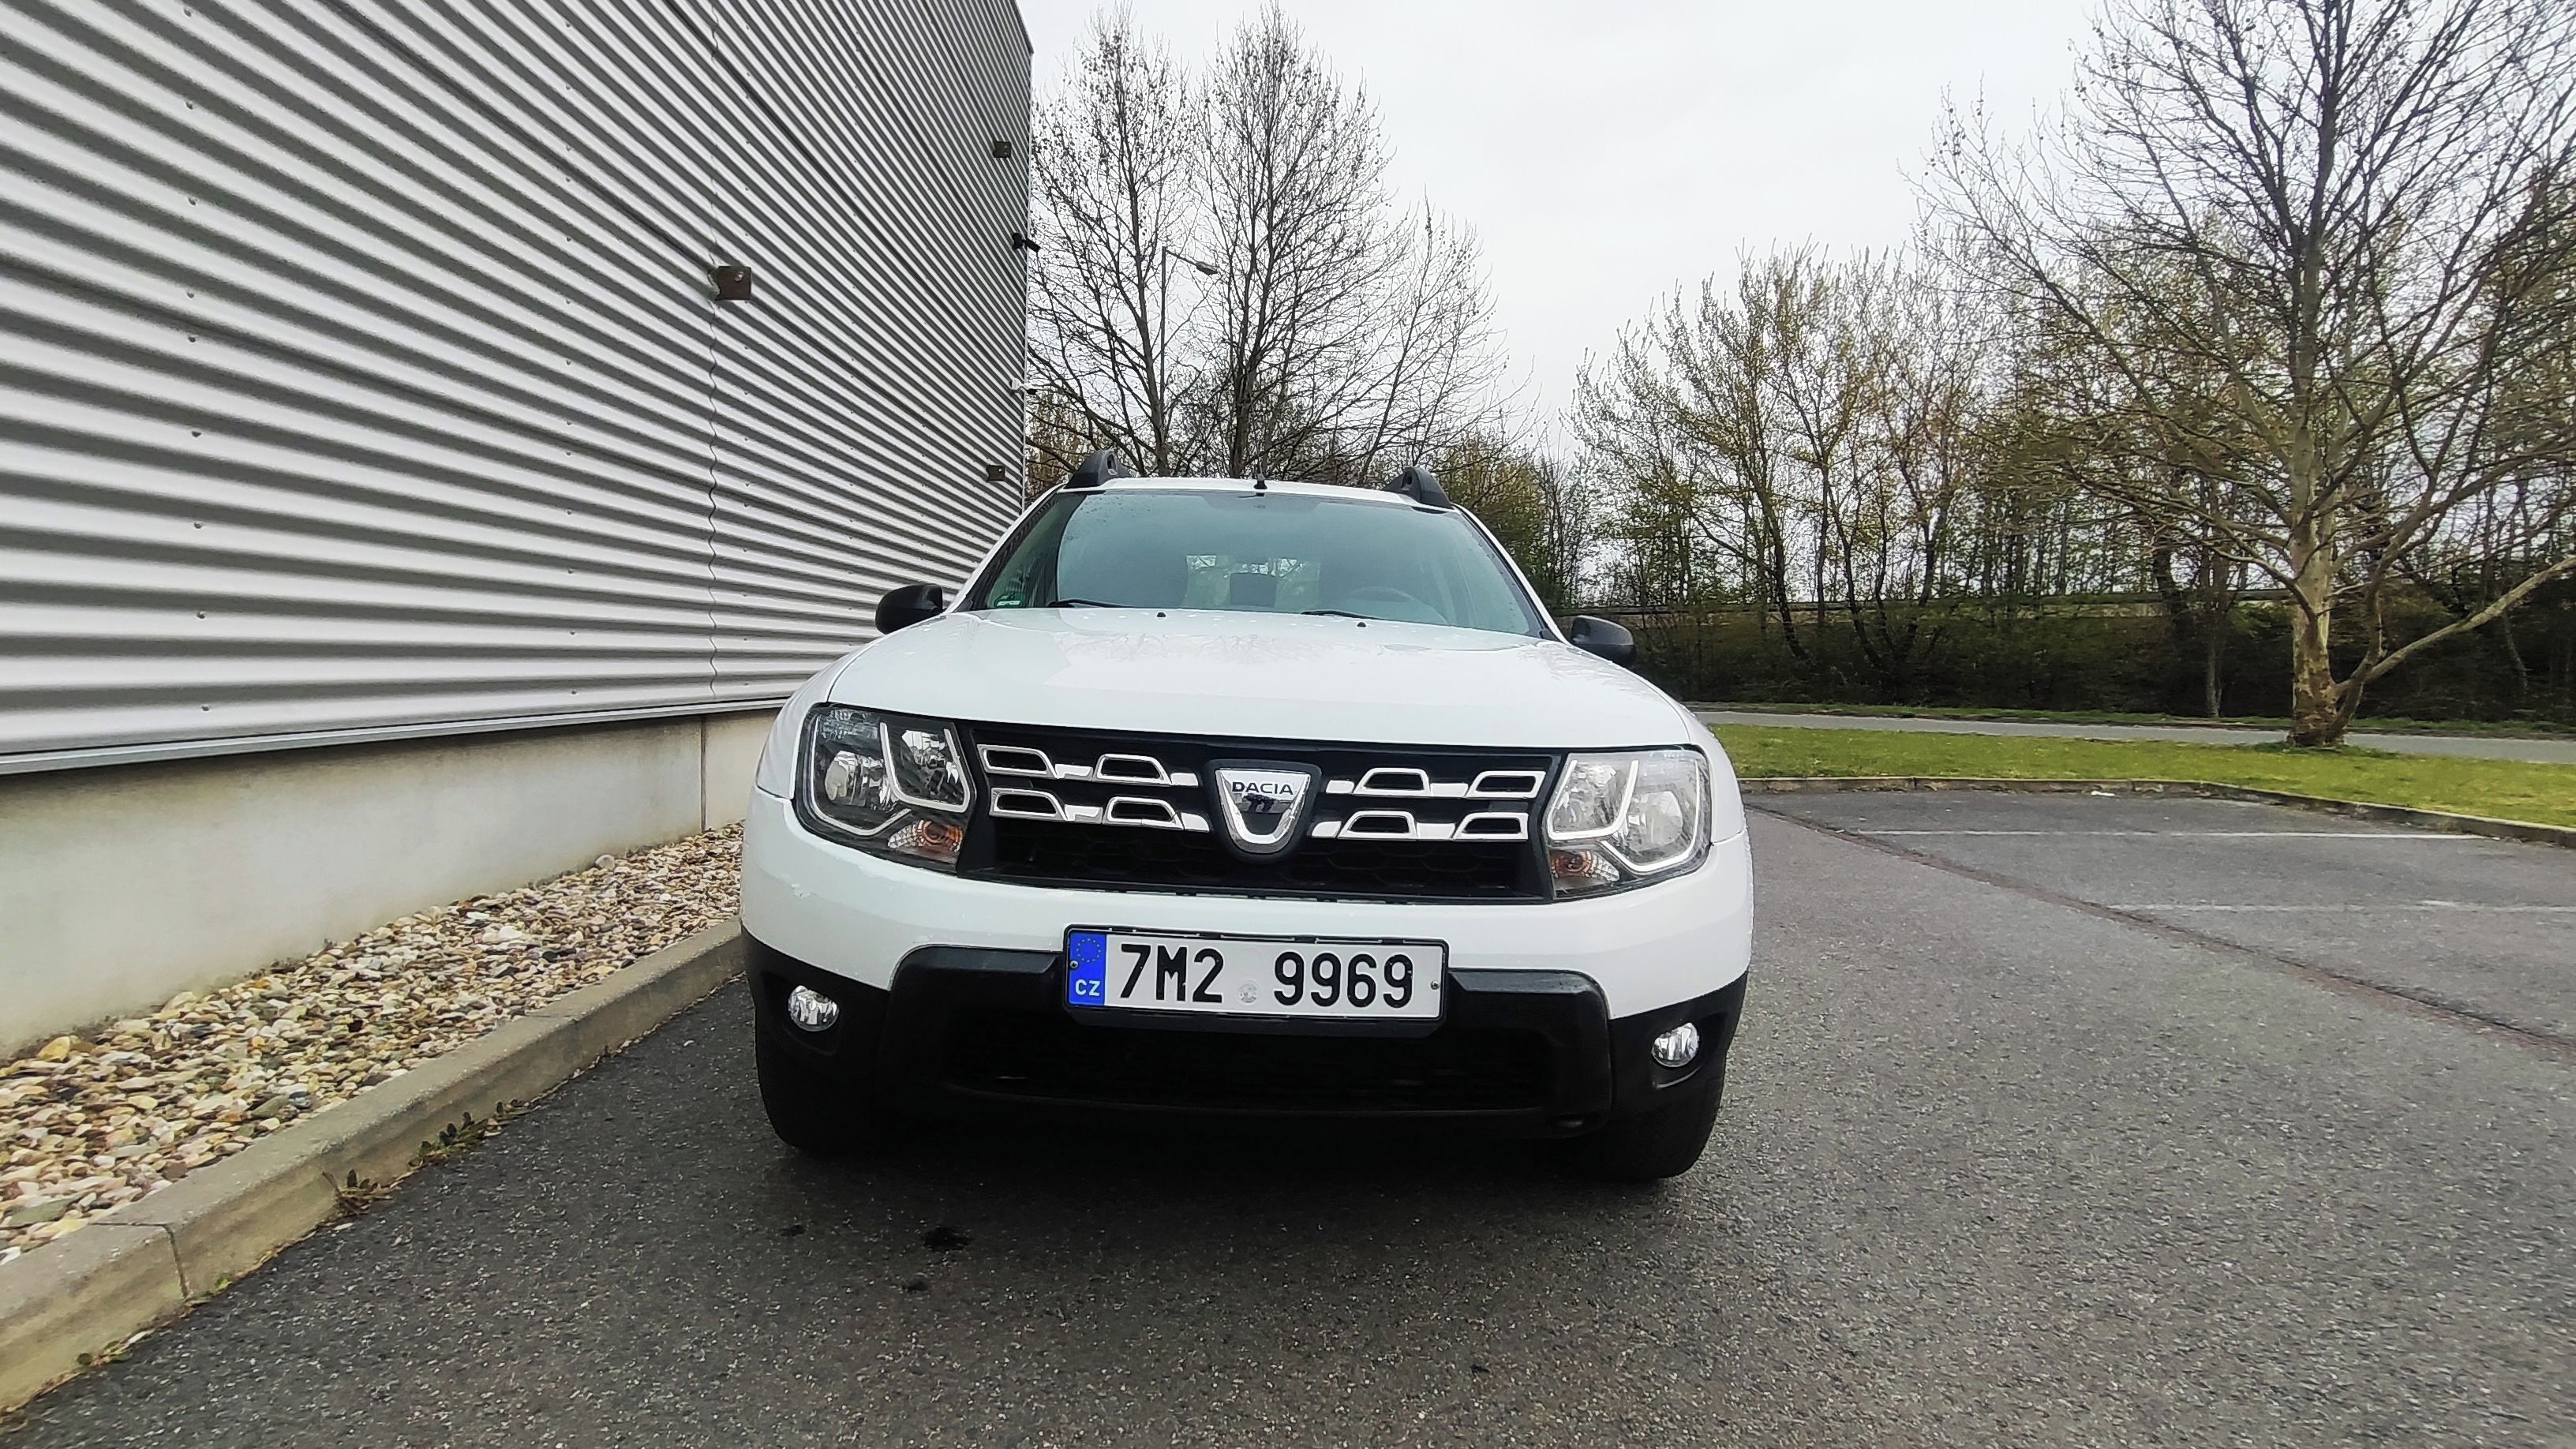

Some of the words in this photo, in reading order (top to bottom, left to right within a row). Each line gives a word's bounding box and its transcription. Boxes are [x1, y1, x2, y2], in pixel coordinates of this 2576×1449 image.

[1231, 781, 1294, 796] DACIA
[1119, 943, 1224, 1004] 7M2
[1273, 951, 1413, 1009] 9969
[1074, 979, 1101, 997] CZ
